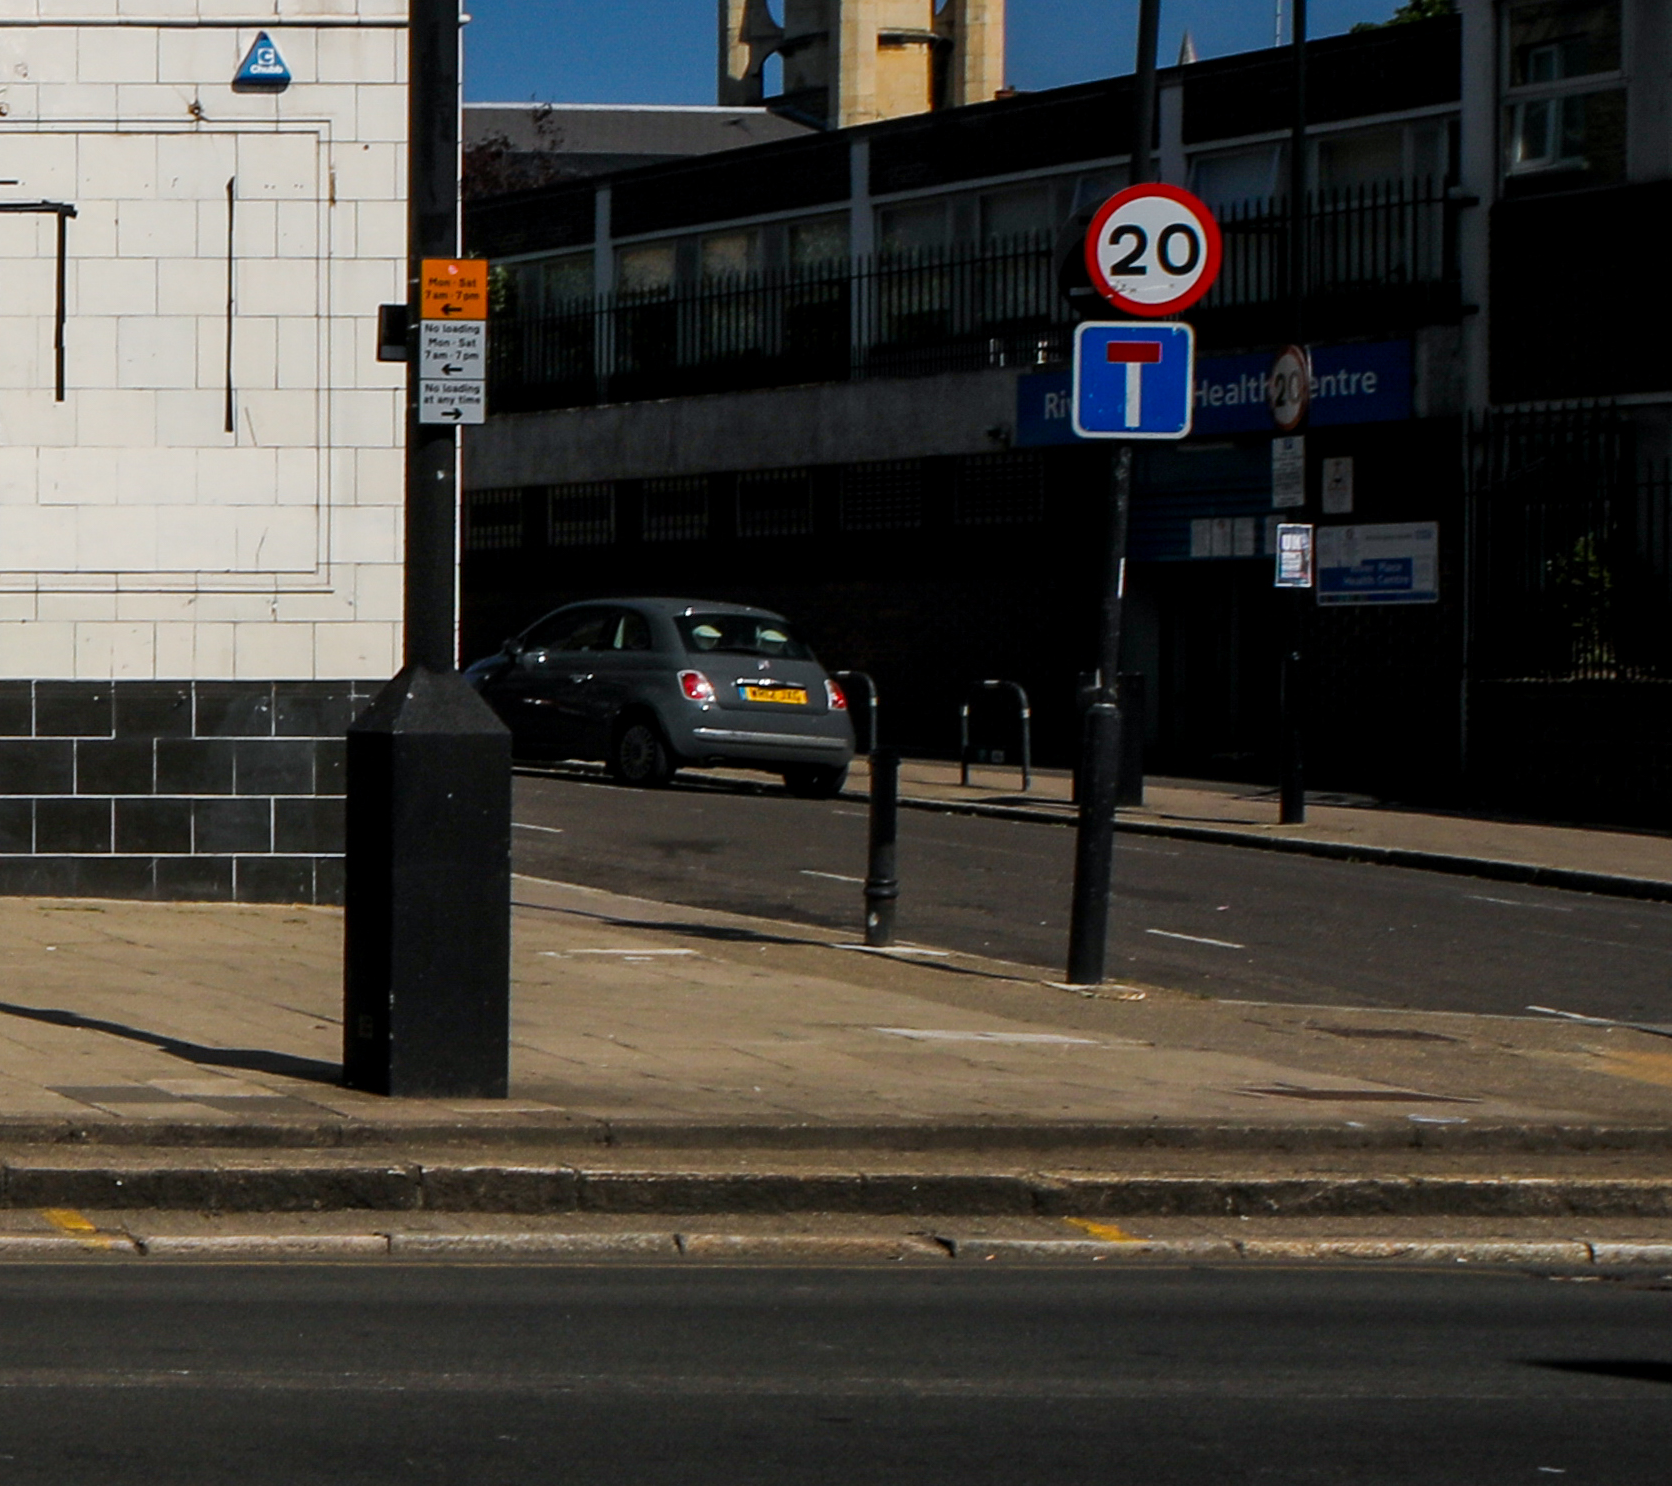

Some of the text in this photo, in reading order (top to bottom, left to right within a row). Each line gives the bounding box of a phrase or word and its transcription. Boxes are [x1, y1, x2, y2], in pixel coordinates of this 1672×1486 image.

[250, 64, 284, 74] Chubb
[1109, 223, 1201, 277] 20
[428, 278, 450, 287] Mon
[459, 278, 476, 287] Sat
[425, 324, 480, 335] No loading
[428, 338, 450, 347] Mon
[459, 338, 476, 347] Sat
[425, 383, 480, 395] No loading
[437, 397, 455, 406] any
[459, 395, 481, 404] time
